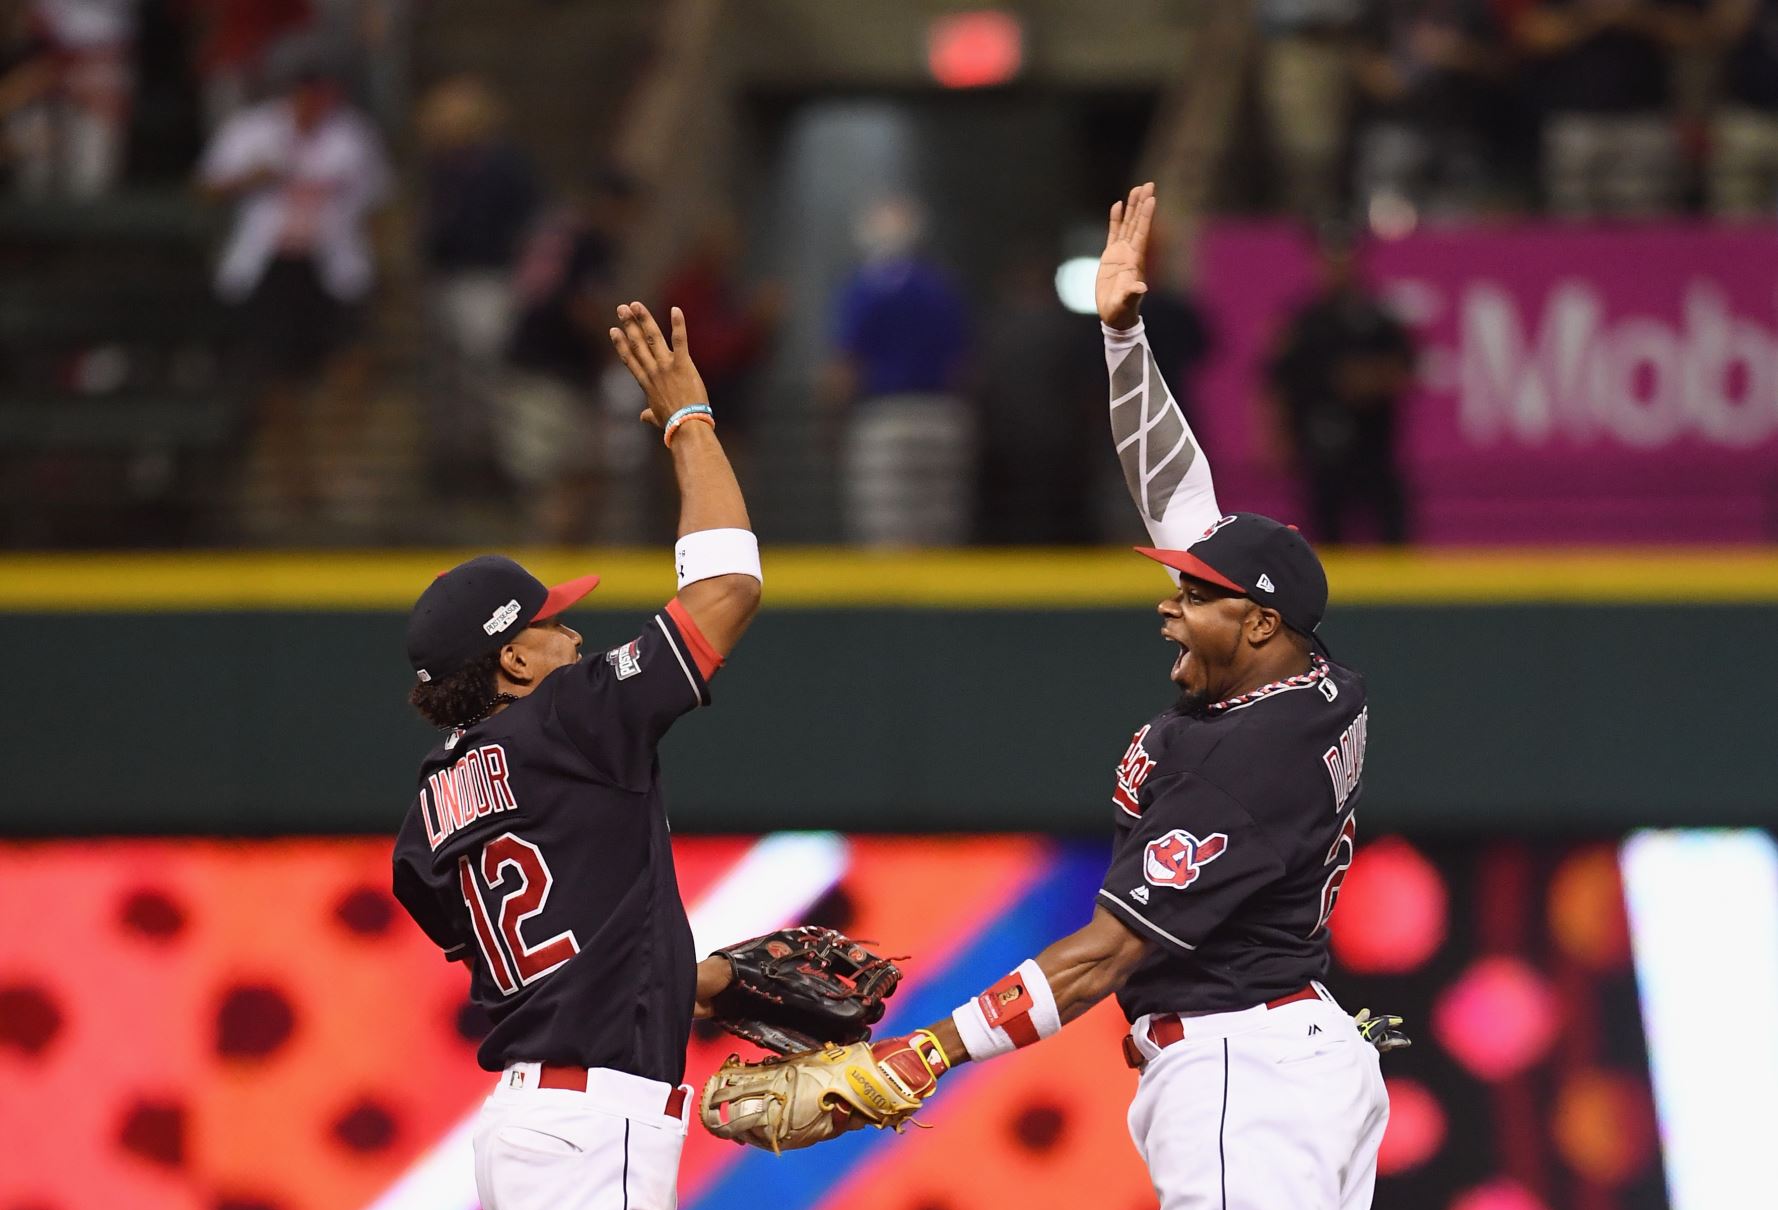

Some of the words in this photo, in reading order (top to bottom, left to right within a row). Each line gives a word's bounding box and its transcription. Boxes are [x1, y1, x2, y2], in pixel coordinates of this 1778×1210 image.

[1383, 276, 1778, 447] -Mob
[420, 743, 518, 852] LINDOR
[458, 832, 581, 997] 12
[851, 1069, 888, 1107] Wilson
